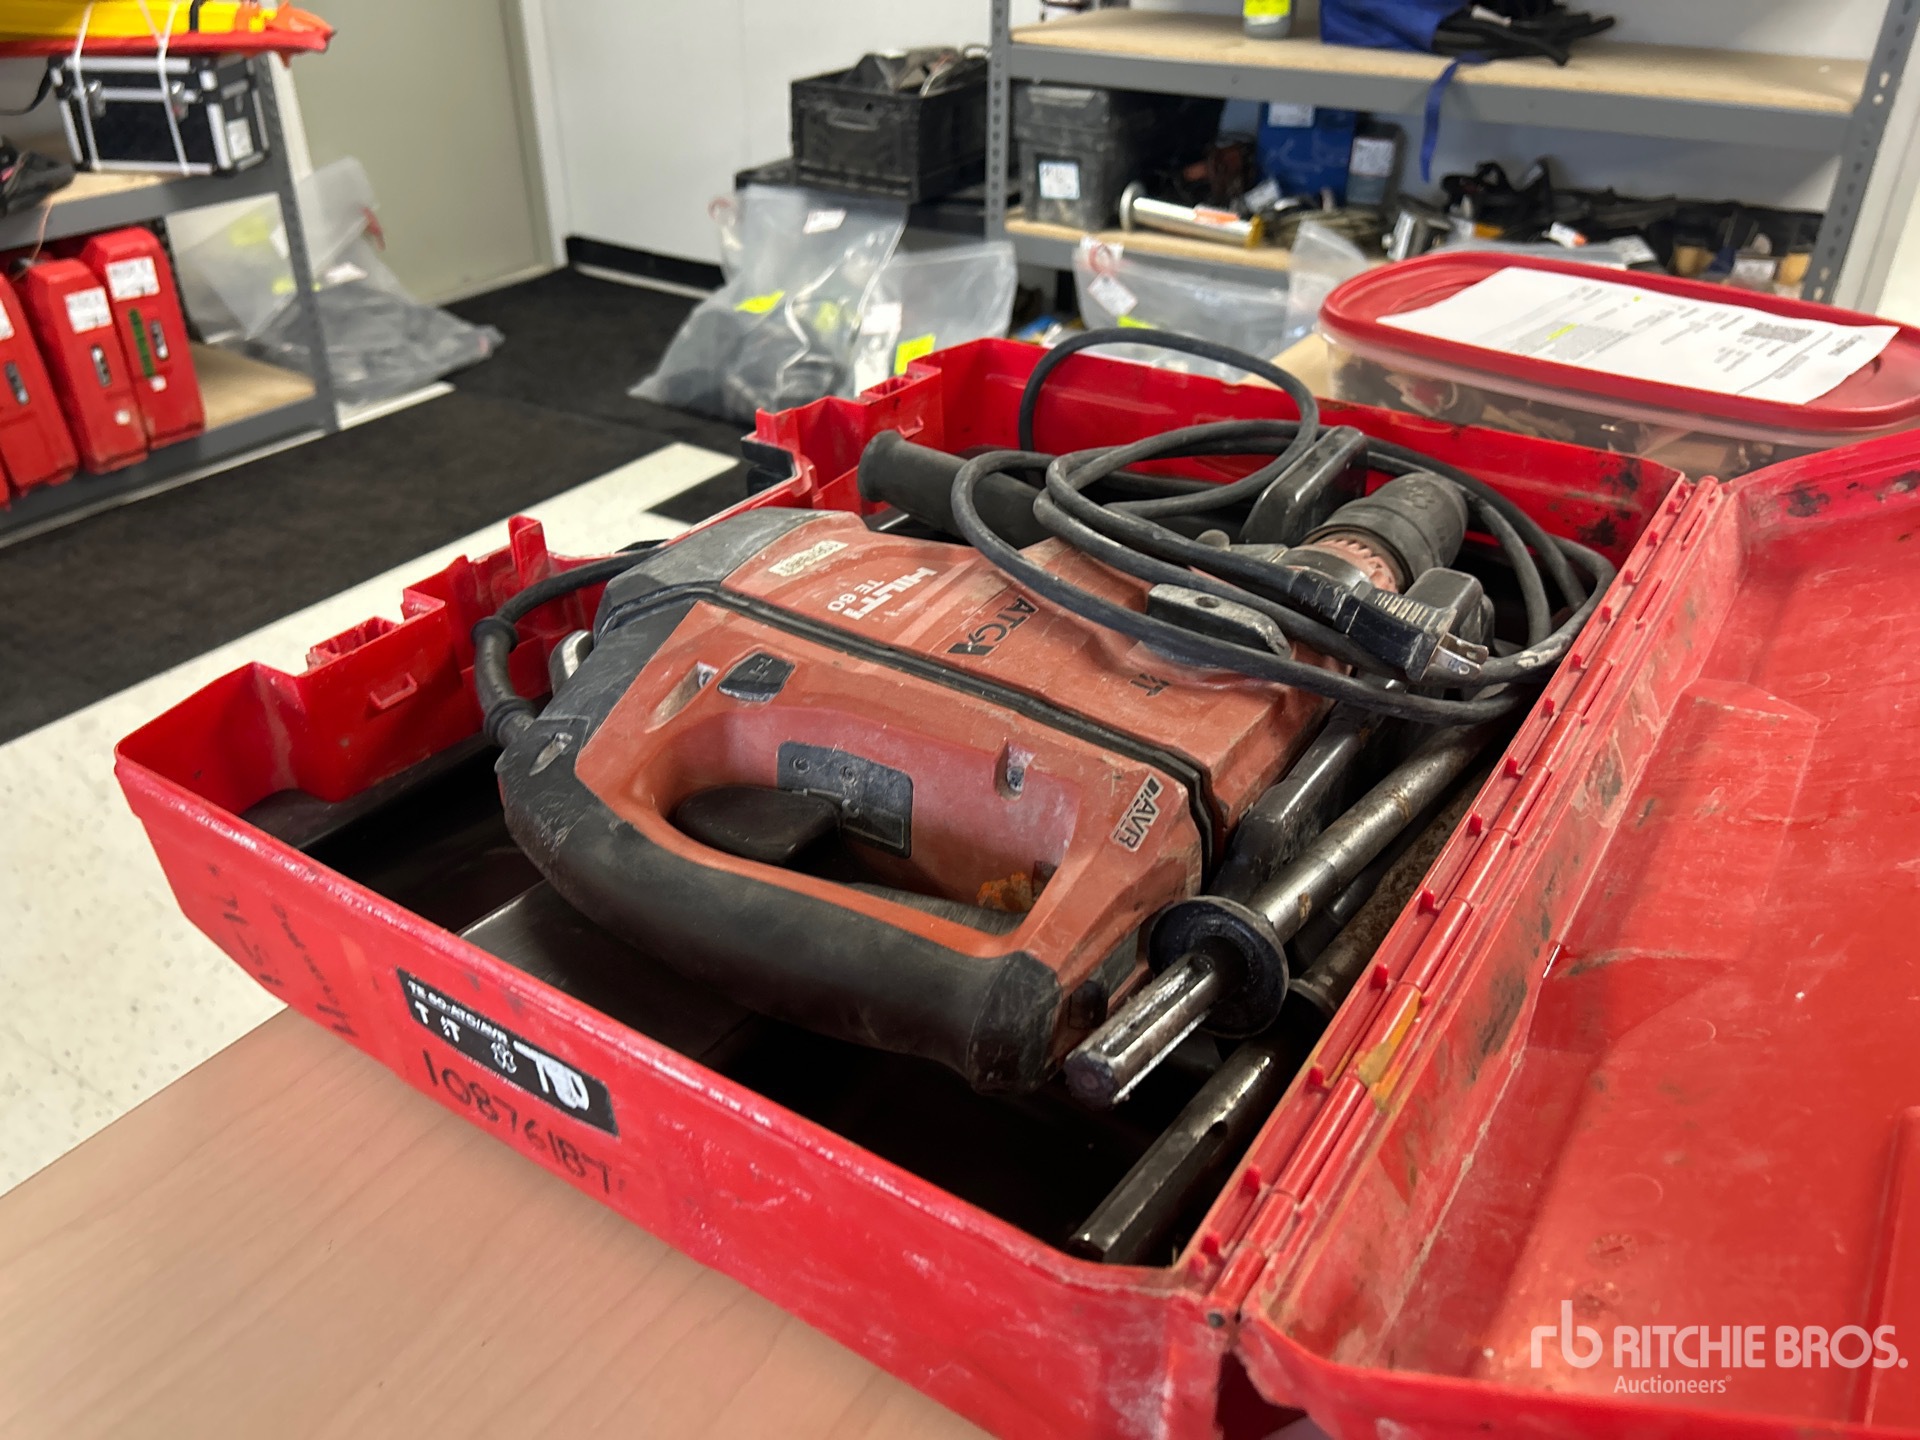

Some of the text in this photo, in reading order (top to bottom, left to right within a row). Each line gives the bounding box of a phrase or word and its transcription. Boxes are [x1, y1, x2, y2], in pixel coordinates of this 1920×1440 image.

[827, 579, 885, 612] TE 60
[842, 567, 938, 620] HILTI
[1118, 797, 1157, 849] AVR
